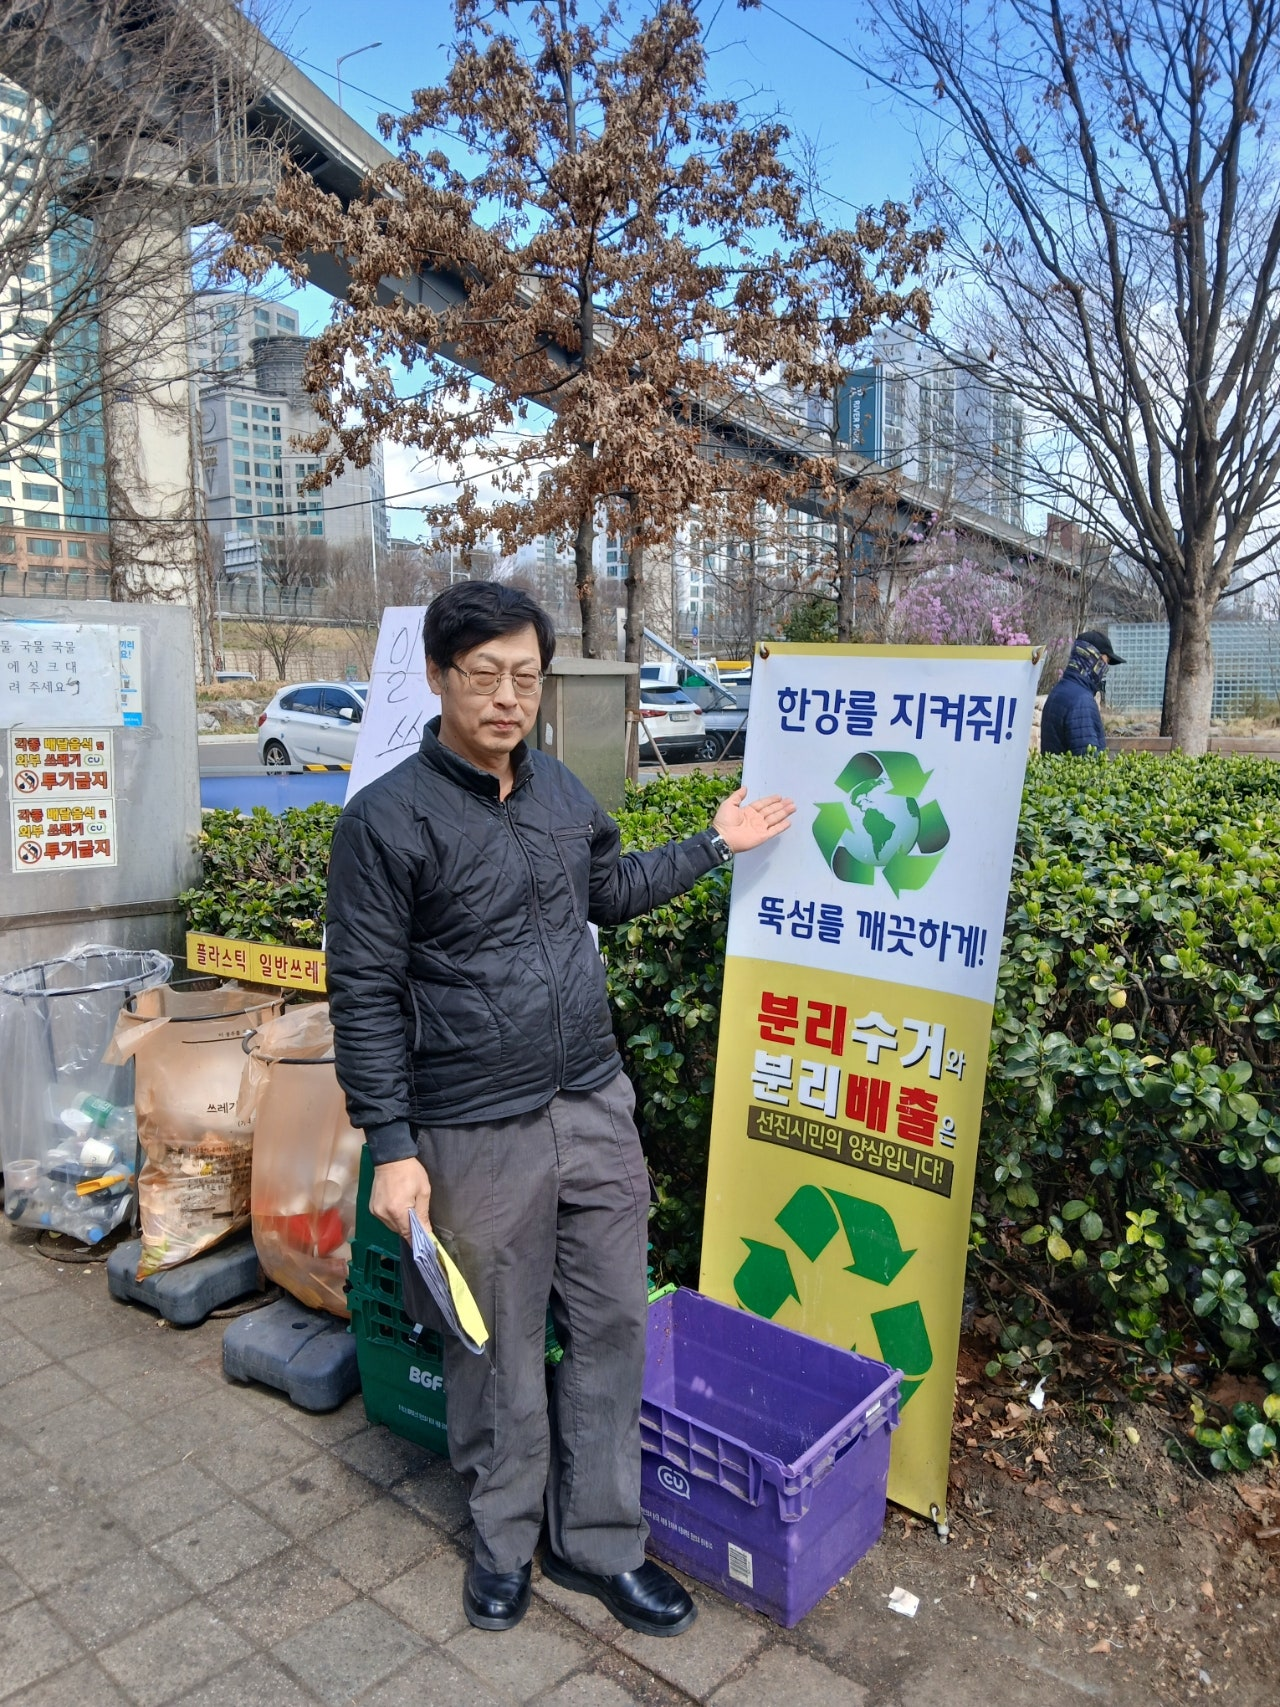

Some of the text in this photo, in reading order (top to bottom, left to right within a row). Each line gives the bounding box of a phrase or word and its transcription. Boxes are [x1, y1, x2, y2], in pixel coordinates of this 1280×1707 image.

[19, 641, 44, 653] 국물
[52, 641, 75, 654] 국물
[777, 686, 1018, 744] 한강를 지켜줘!
[15, 738, 41, 752] 각종
[44, 737, 93, 752] 배달음식
[15, 753, 81, 767] 외부 쓰레기
[41, 771, 108, 790] 투기금지
[18, 808, 43, 823] 각종
[47, 807, 95, 821] 배달음식
[19, 822, 84, 838] 외부 쓰레기
[44, 839, 110, 860] 투기금지
[757, 896, 988, 968] 뚝섬를 깨끗하게!
[196, 943, 246, 972] 플라스틱
[259, 953, 326, 984] 일반쓰레
[757, 991, 966, 1081] 분리수거와
[751, 1048, 957, 1148] 분리배출은
[756, 1110, 945, 1185] 선진시민의 양심입니다!
[663, 1472, 683, 1490] CU
